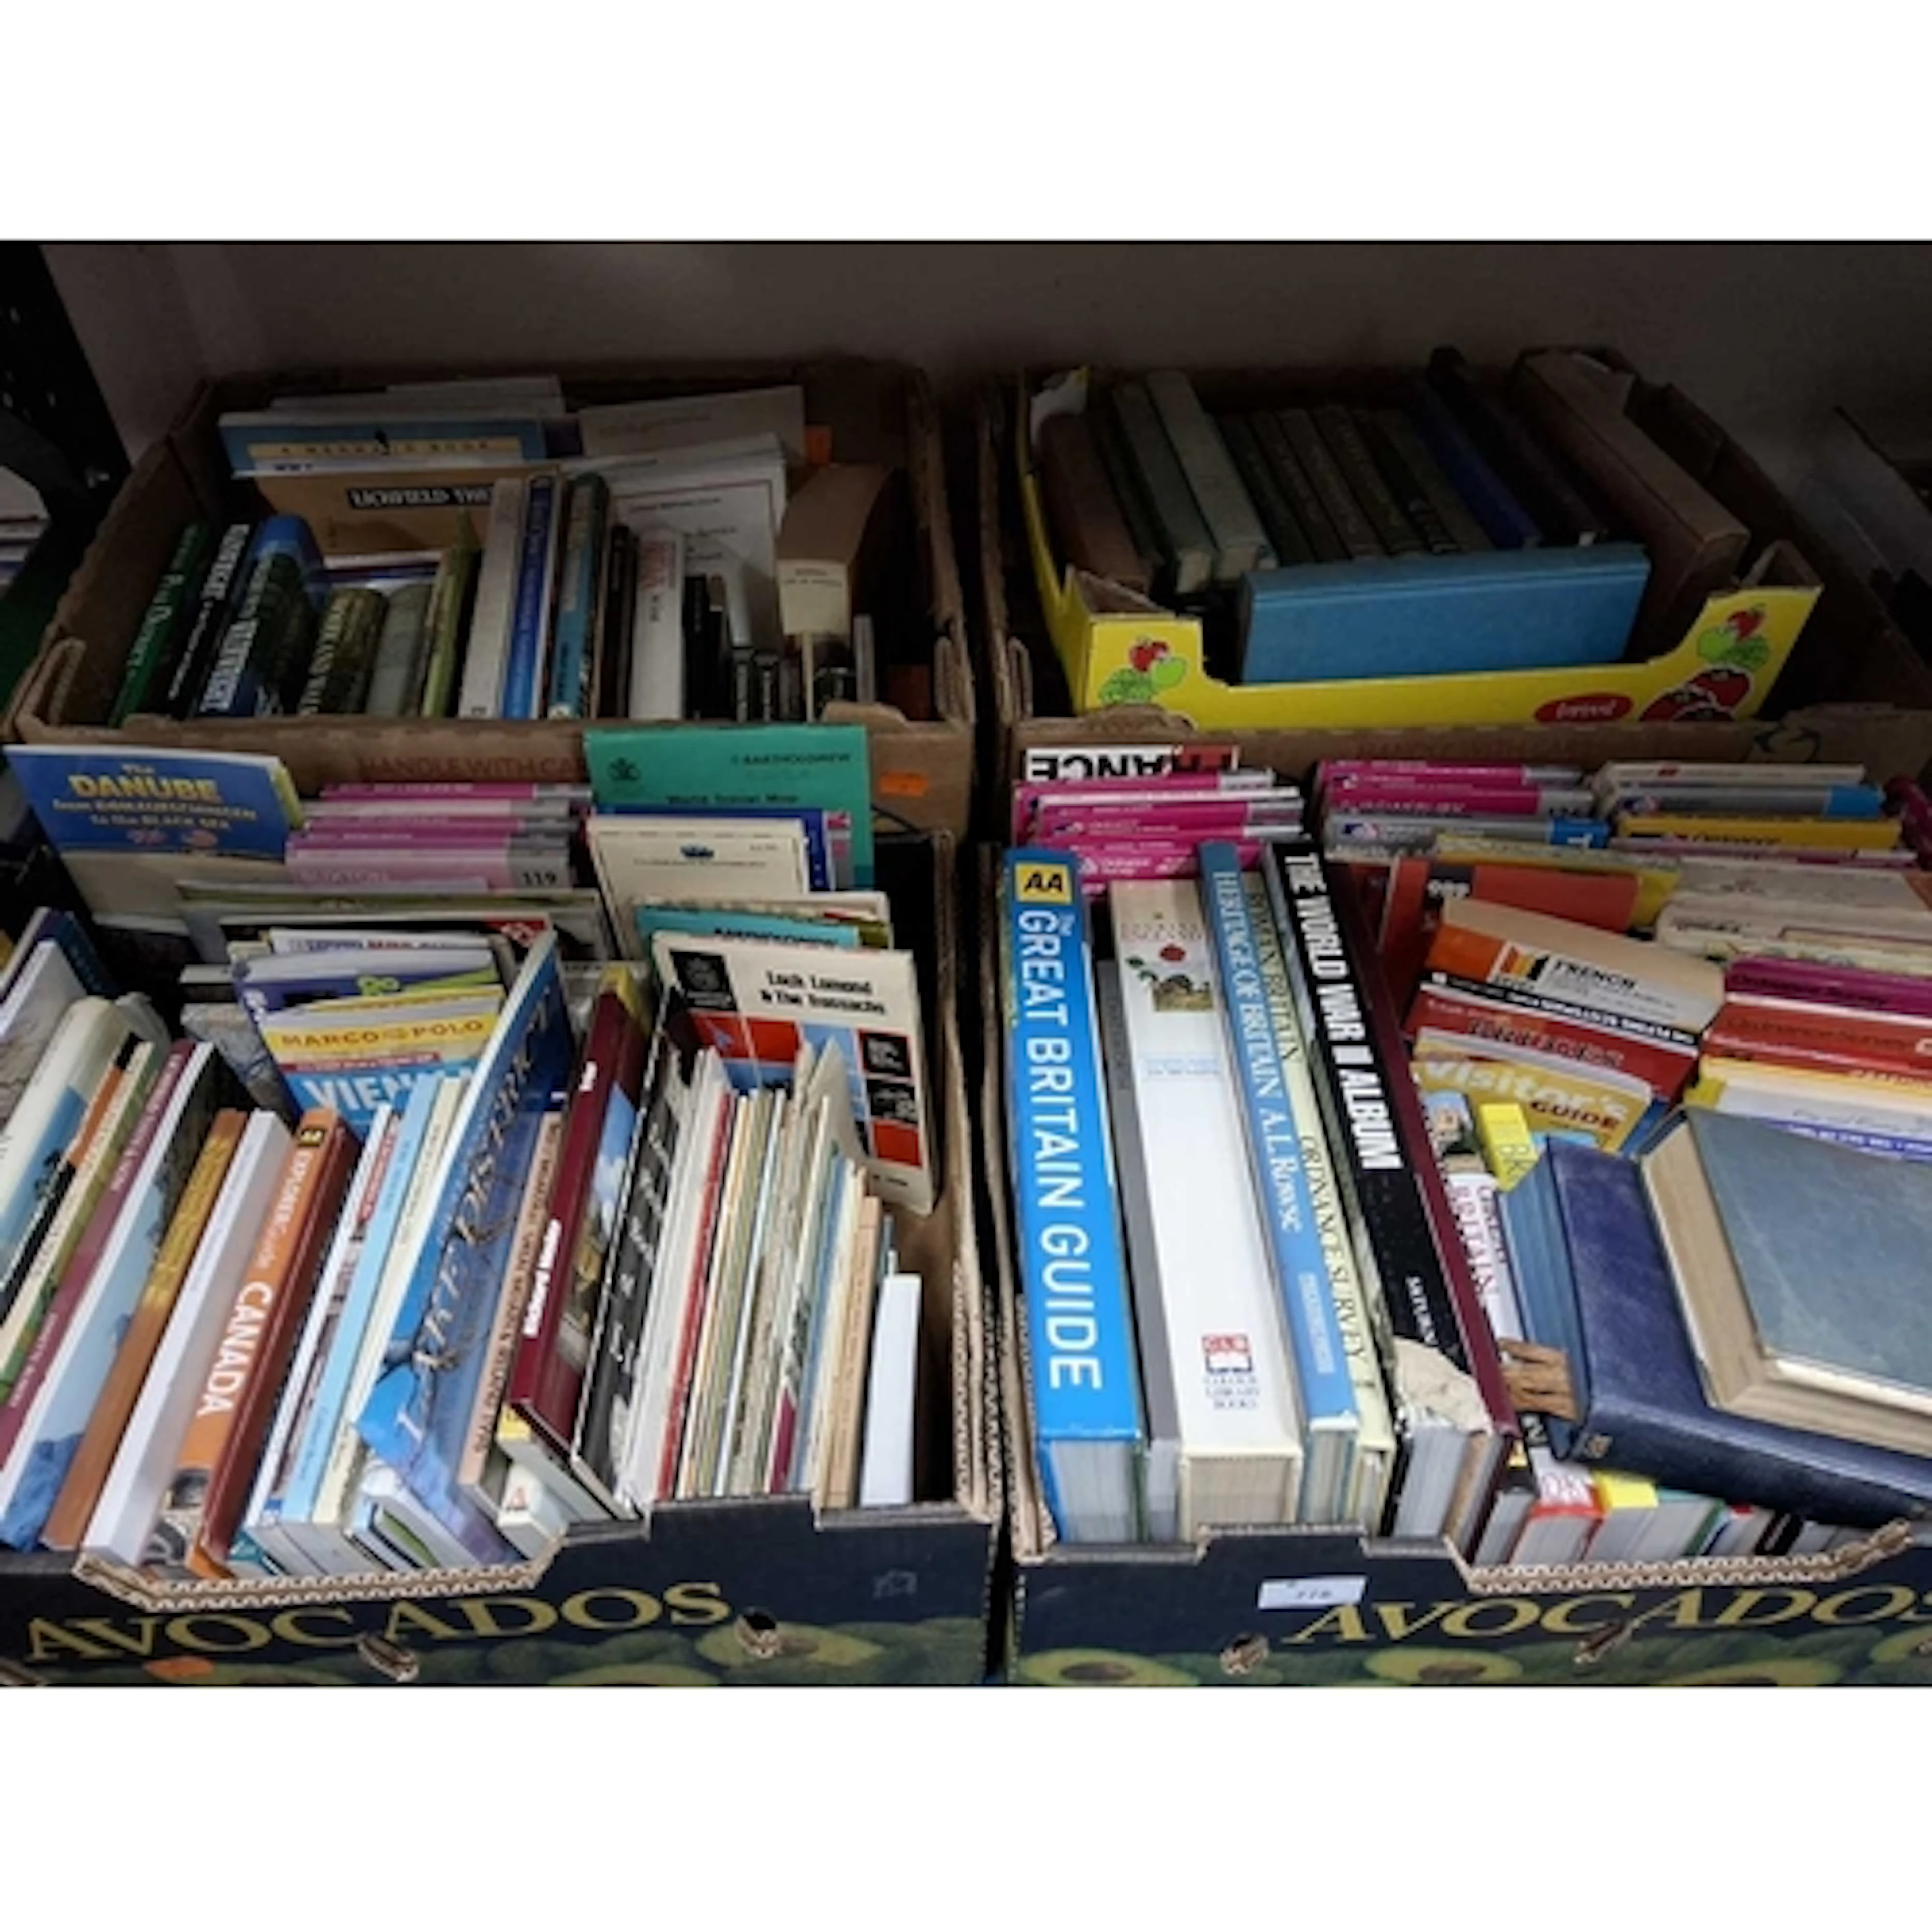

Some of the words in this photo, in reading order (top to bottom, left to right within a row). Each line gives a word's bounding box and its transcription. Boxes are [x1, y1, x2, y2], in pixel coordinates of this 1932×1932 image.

[68, 774, 220, 803] DANUBE
[520, 872, 556, 885] 119
[1024, 872, 1062, 893] AA
[1284, 853, 1327, 893] THE
[1018, 911, 1068, 1026] GREAT
[1297, 895, 1347, 979] WORLD
[281, 1030, 380, 1048] MARCO
[412, 1020, 484, 1037] POLO
[1241, 1001, 1284, 1099] BRITAIN
[1319, 985, 1365, 1041] WAR
[1025, 1038, 1085, 1208] BRITAIN
[1339, 1068, 1403, 1170] ALBUM
[1530, 1100, 1622, 1130] GUIDE
[1039, 1223, 1103, 1390] GUIDE
[197, 1280, 272, 1417] CANADA
[29, 1581, 732, 1661] AVOCADOS
